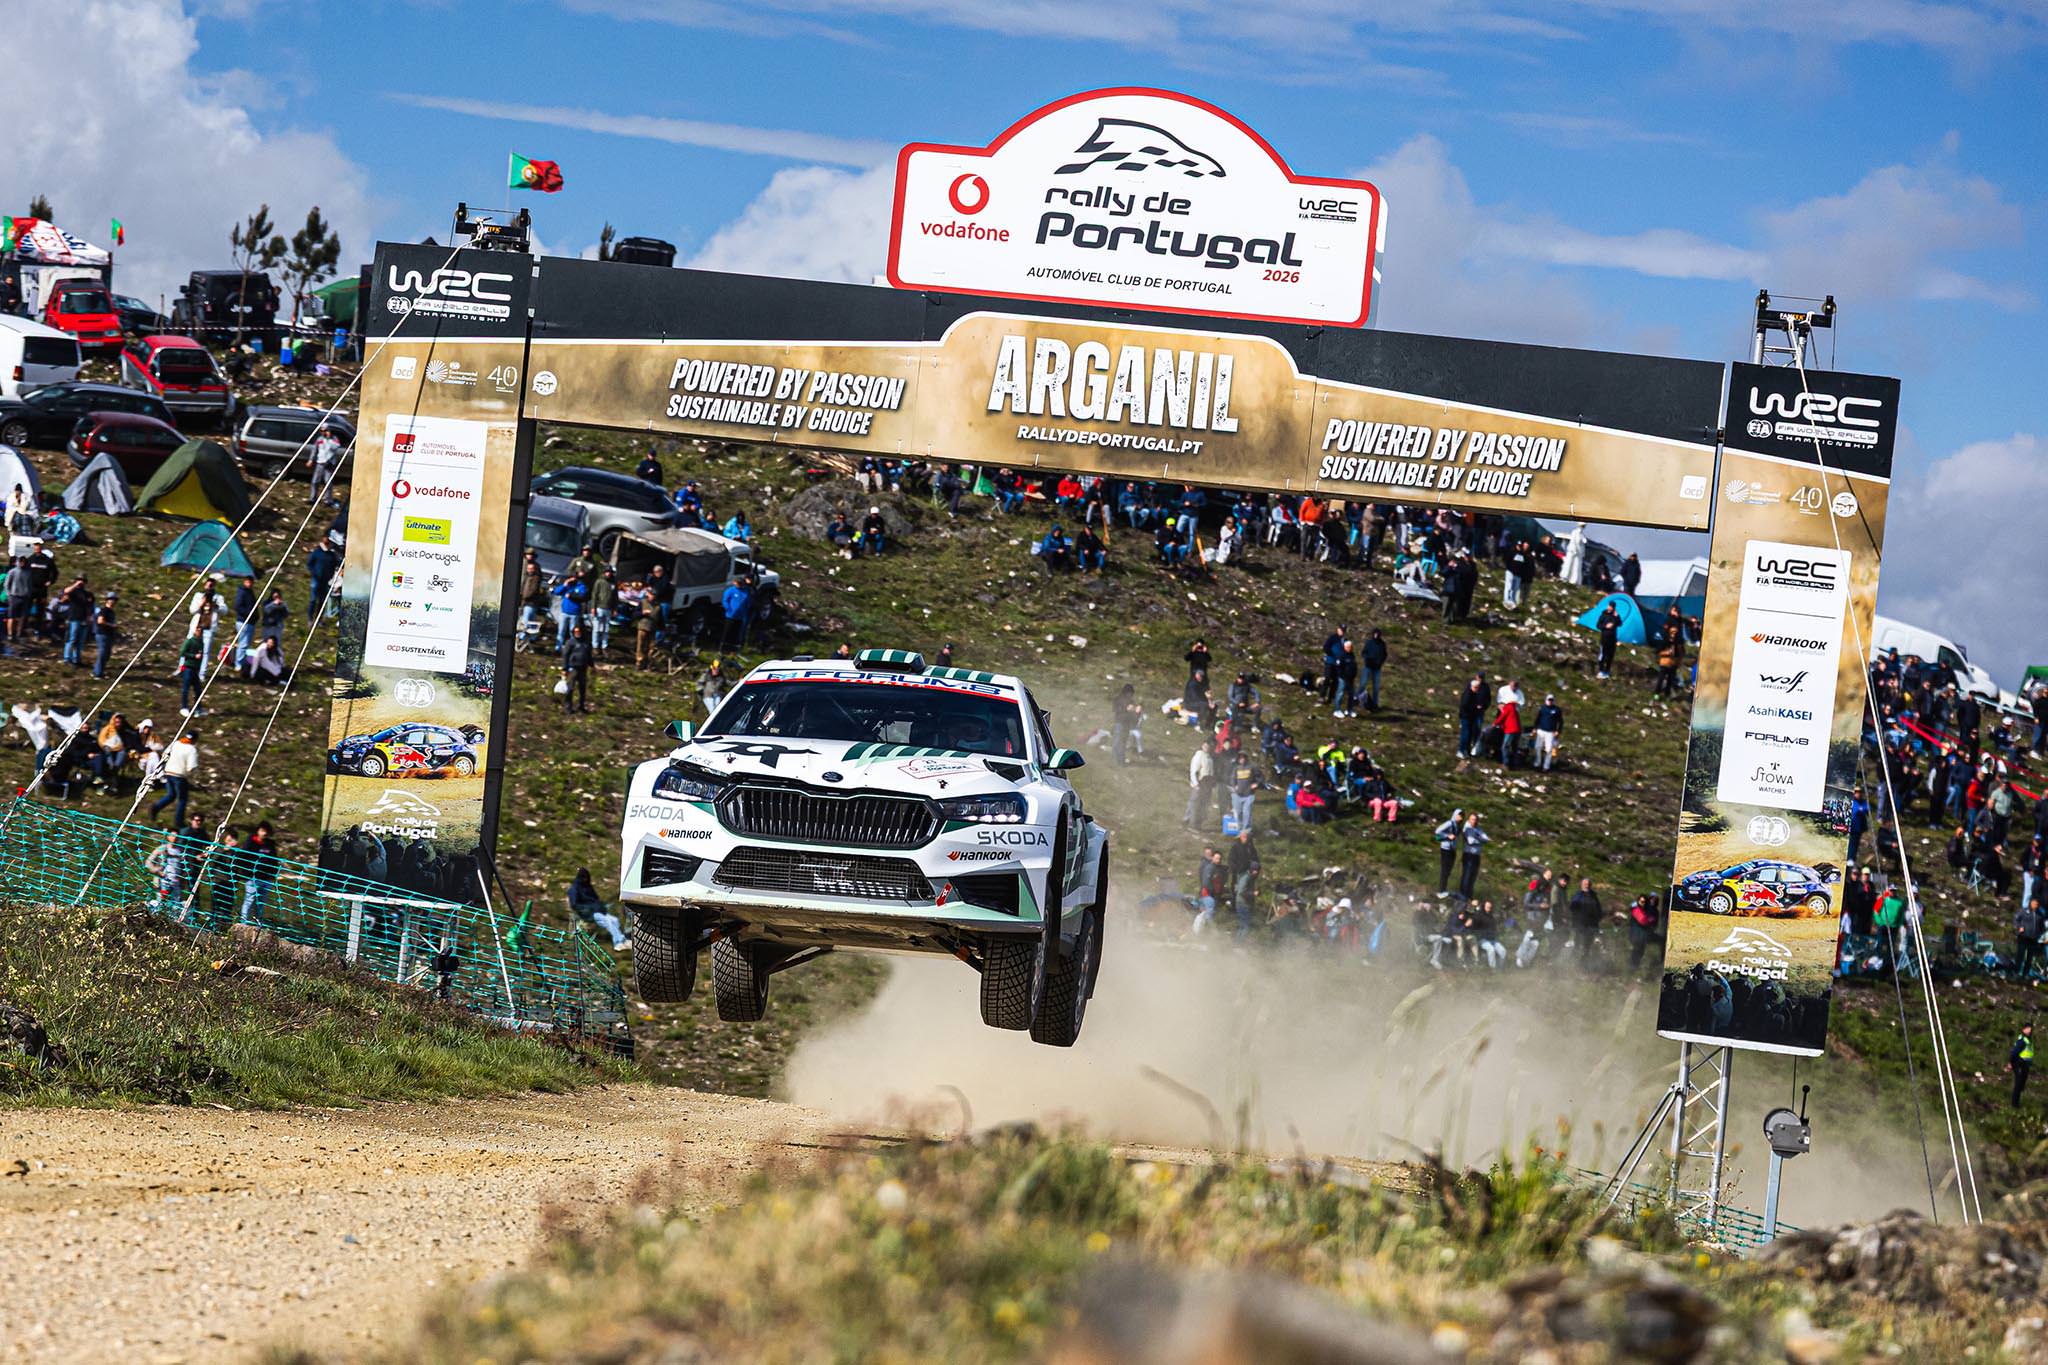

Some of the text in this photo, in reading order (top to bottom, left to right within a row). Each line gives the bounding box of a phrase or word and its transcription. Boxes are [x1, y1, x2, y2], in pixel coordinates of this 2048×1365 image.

[1044, 186, 1192, 216] rally de
[921, 221, 1009, 241] vodafone
[1035, 211, 1303, 269] Portugal
[1026, 266, 1233, 294] AUTOMÓVEL CLUB DE PORTUGAL
[1262, 269, 1300, 283] 2026
[487, 365, 518, 388] 40
[668, 357, 906, 410] POWERED BY PASSION
[987, 335, 1239, 432] ARGANIL
[666, 394, 873, 435] SUSTAINABLE BY CHOICE
[1017, 425, 1203, 455] RALLYDEPORTUGAL.PT
[1321, 418, 1566, 471] POWERED BY PASSION
[445, 451, 477, 459] PORTUGAL
[1319, 455, 1533, 497] SUSTAINABLE BY CHOICE
[415, 486, 471, 499] vodafone
[1791, 486, 1823, 509] 40
[406, 521, 442, 532] ultimate
[400, 549, 418, 558] visit
[389, 599, 412, 608] Hertz
[401, 645, 446, 656] SUSTENTÁVEL
[803, 670, 1001, 695] FORUM8
[1748, 705, 1812, 721] AsahiKASEI
[1758, 786, 1787, 795] WATCHES
[361, 821, 438, 840] Portugal
[1706, 960, 1789, 981] Portugal
